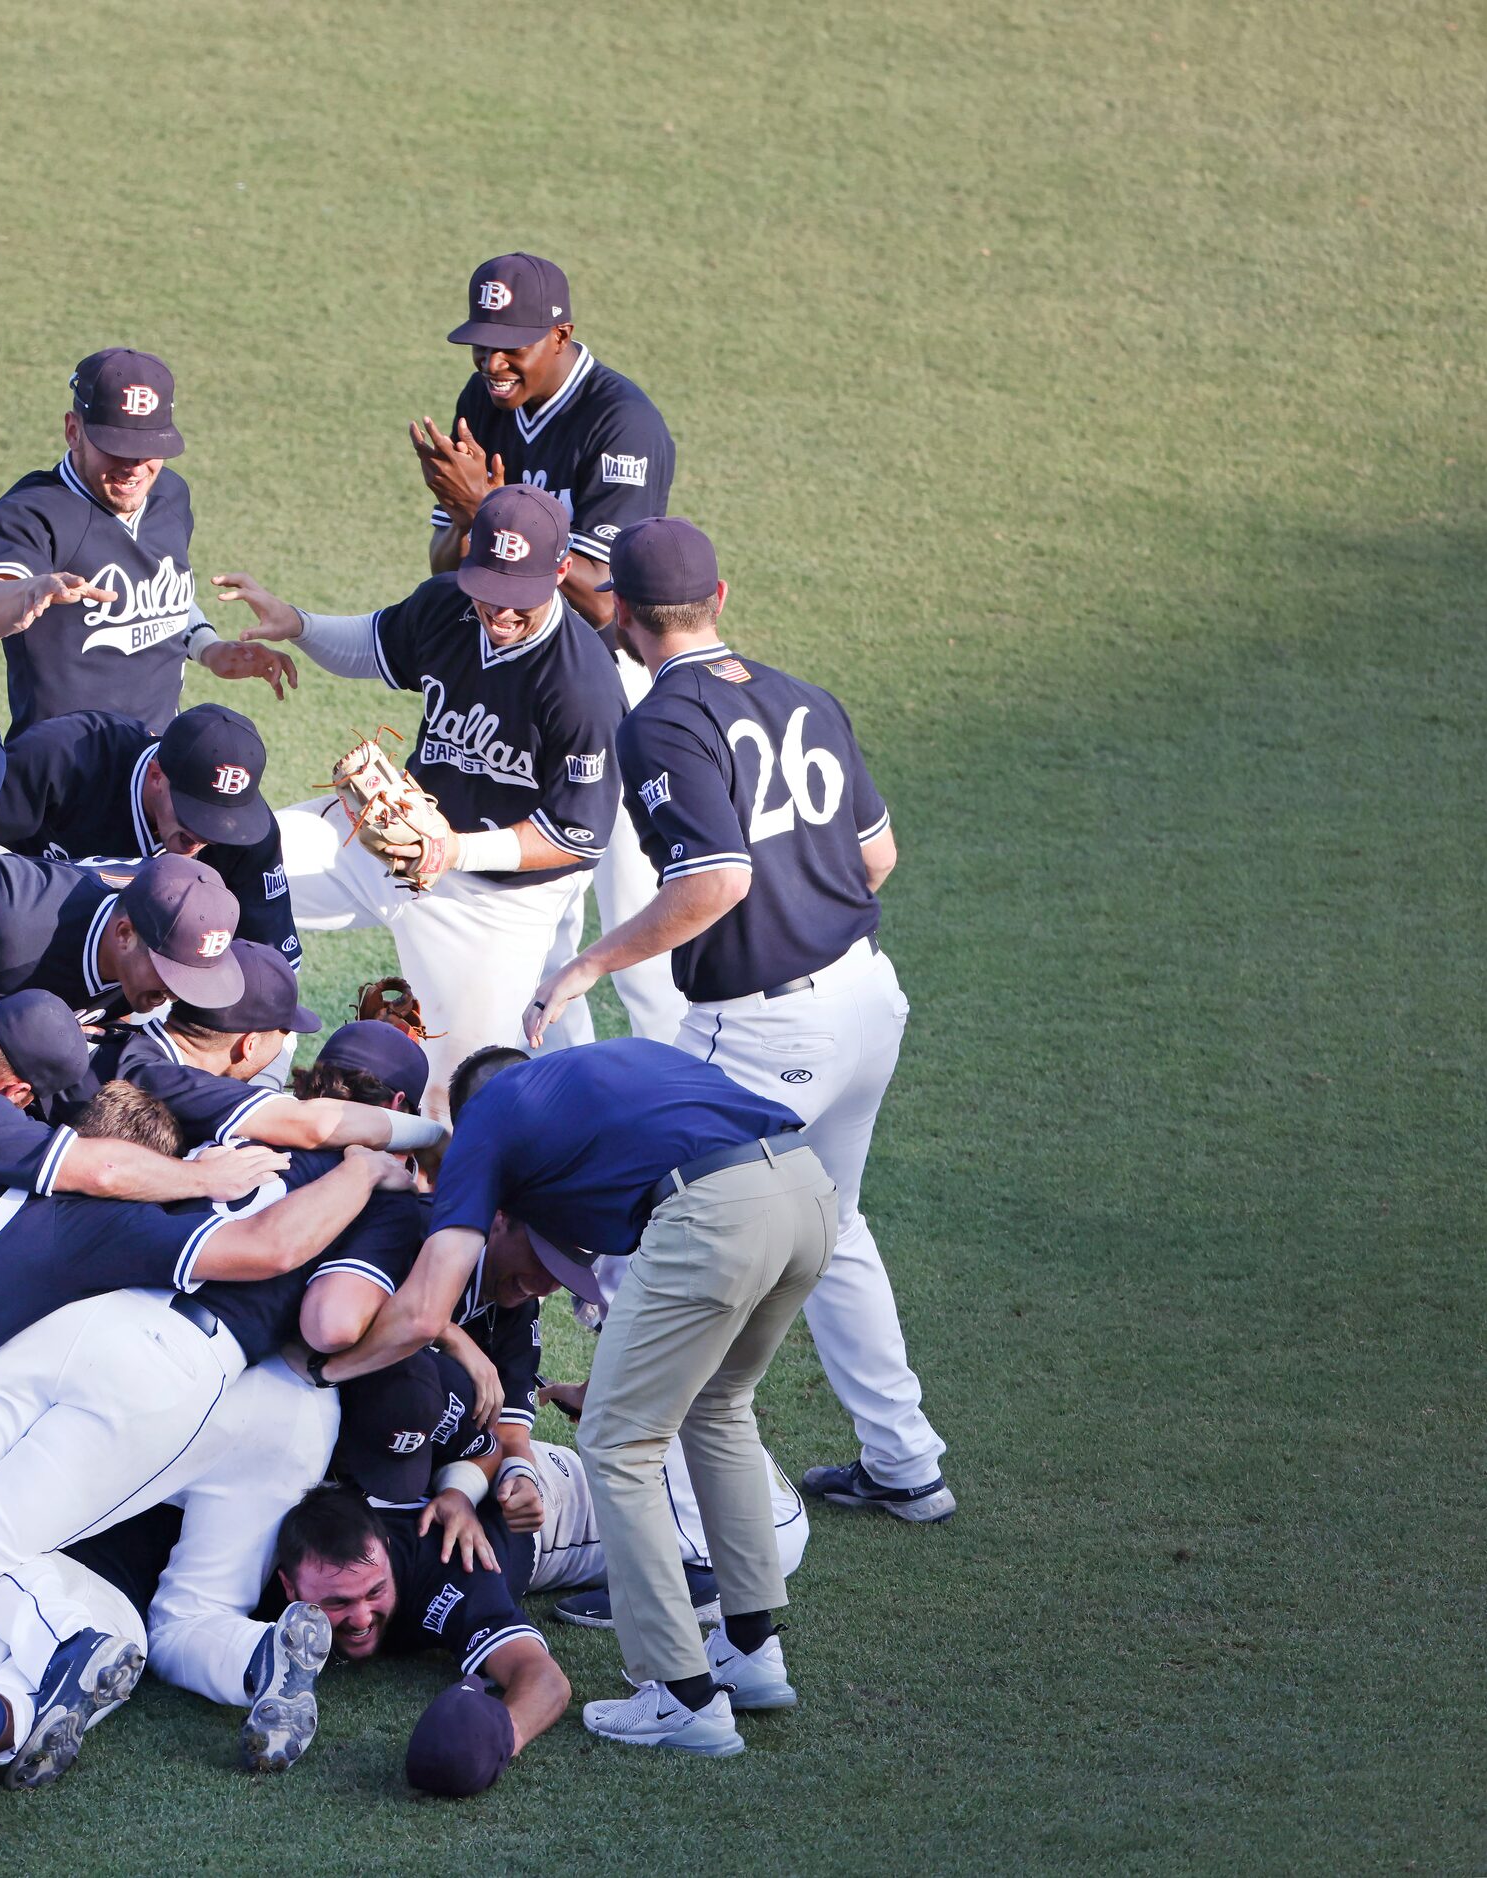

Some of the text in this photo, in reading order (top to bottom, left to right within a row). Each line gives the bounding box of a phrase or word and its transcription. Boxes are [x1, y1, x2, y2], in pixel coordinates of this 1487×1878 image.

[604, 456, 645, 480] VALLEY
[82, 555, 195, 627] Dalla
[727, 706, 844, 844] 26
[423, 1584, 458, 1631] VALLEY
